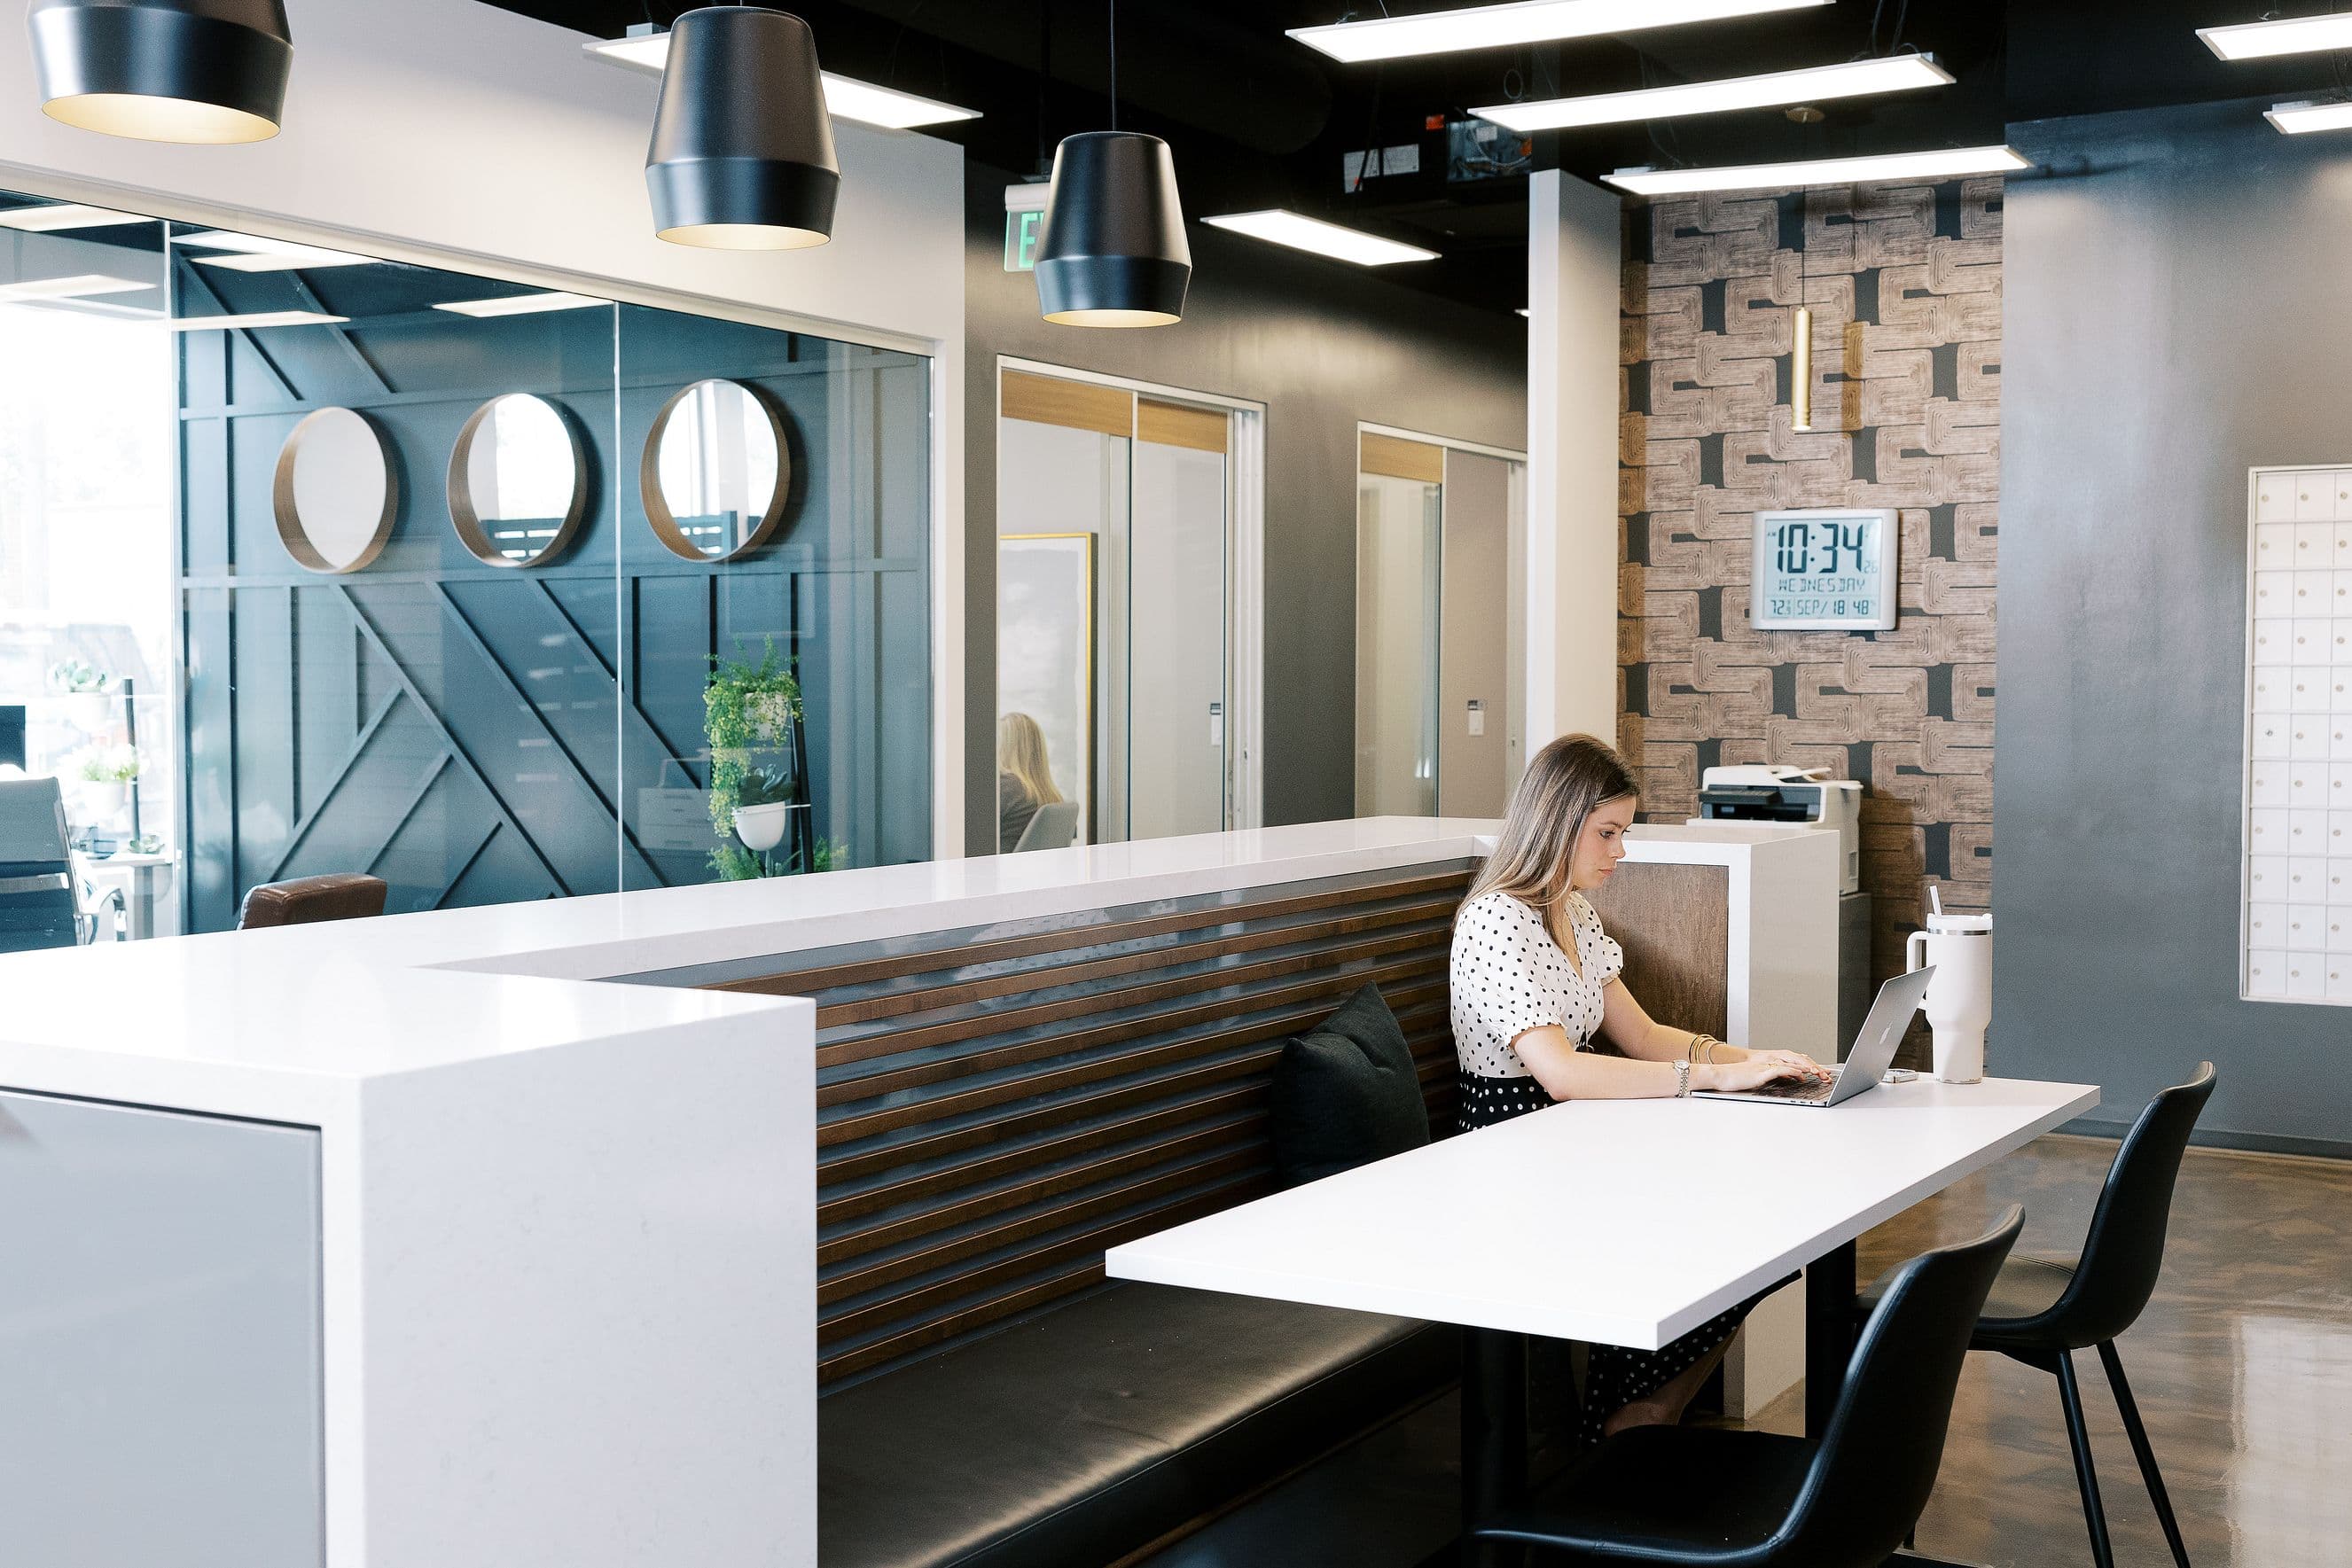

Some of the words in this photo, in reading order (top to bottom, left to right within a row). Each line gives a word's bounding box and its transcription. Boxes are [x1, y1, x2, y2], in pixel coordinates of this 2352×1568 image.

[1778, 523, 1864, 573] 10:34
[1778, 578, 1865, 593] WEDNESDAY
[1833, 599, 1845, 615] 18
